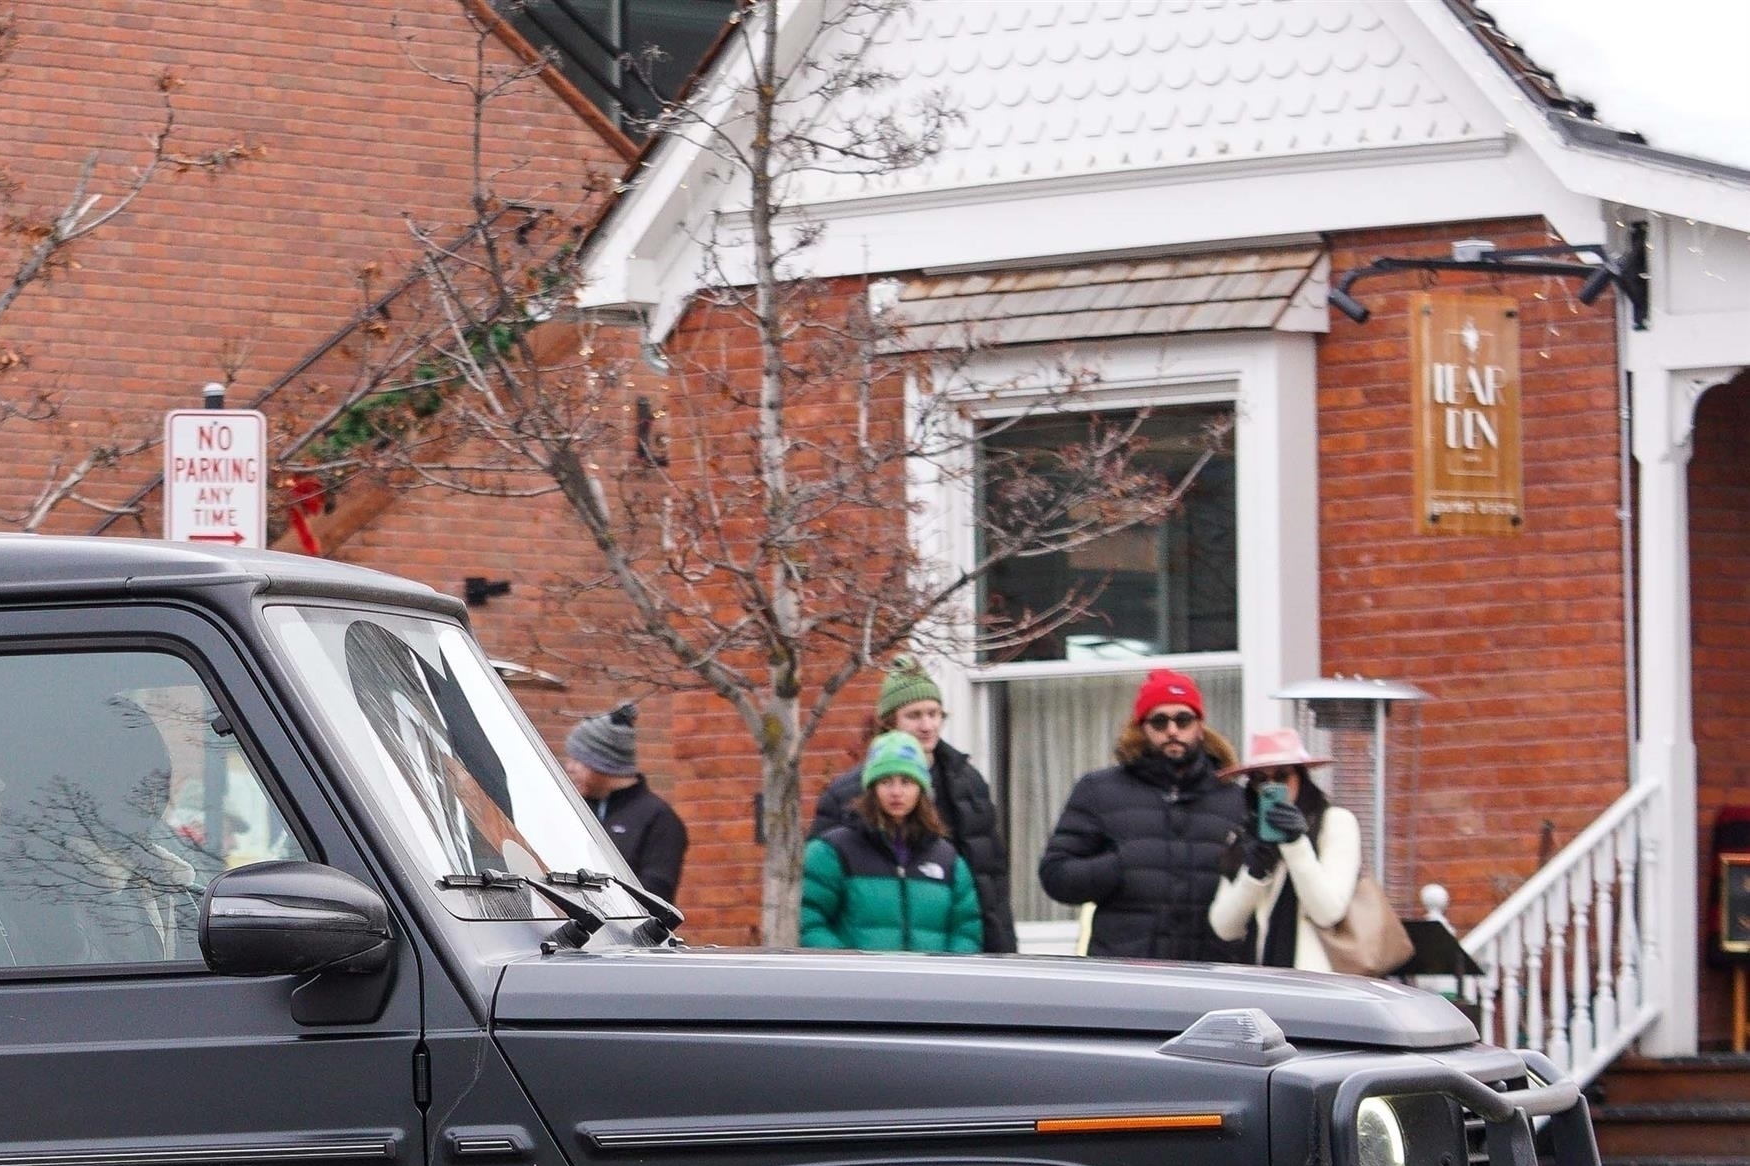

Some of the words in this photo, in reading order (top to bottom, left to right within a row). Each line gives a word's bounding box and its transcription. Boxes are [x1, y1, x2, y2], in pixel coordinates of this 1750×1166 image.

[197, 425, 233, 451] NO
[174, 457, 257, 482] PARKING
[197, 487, 234, 505] ANY
[193, 509, 238, 527] TIME
